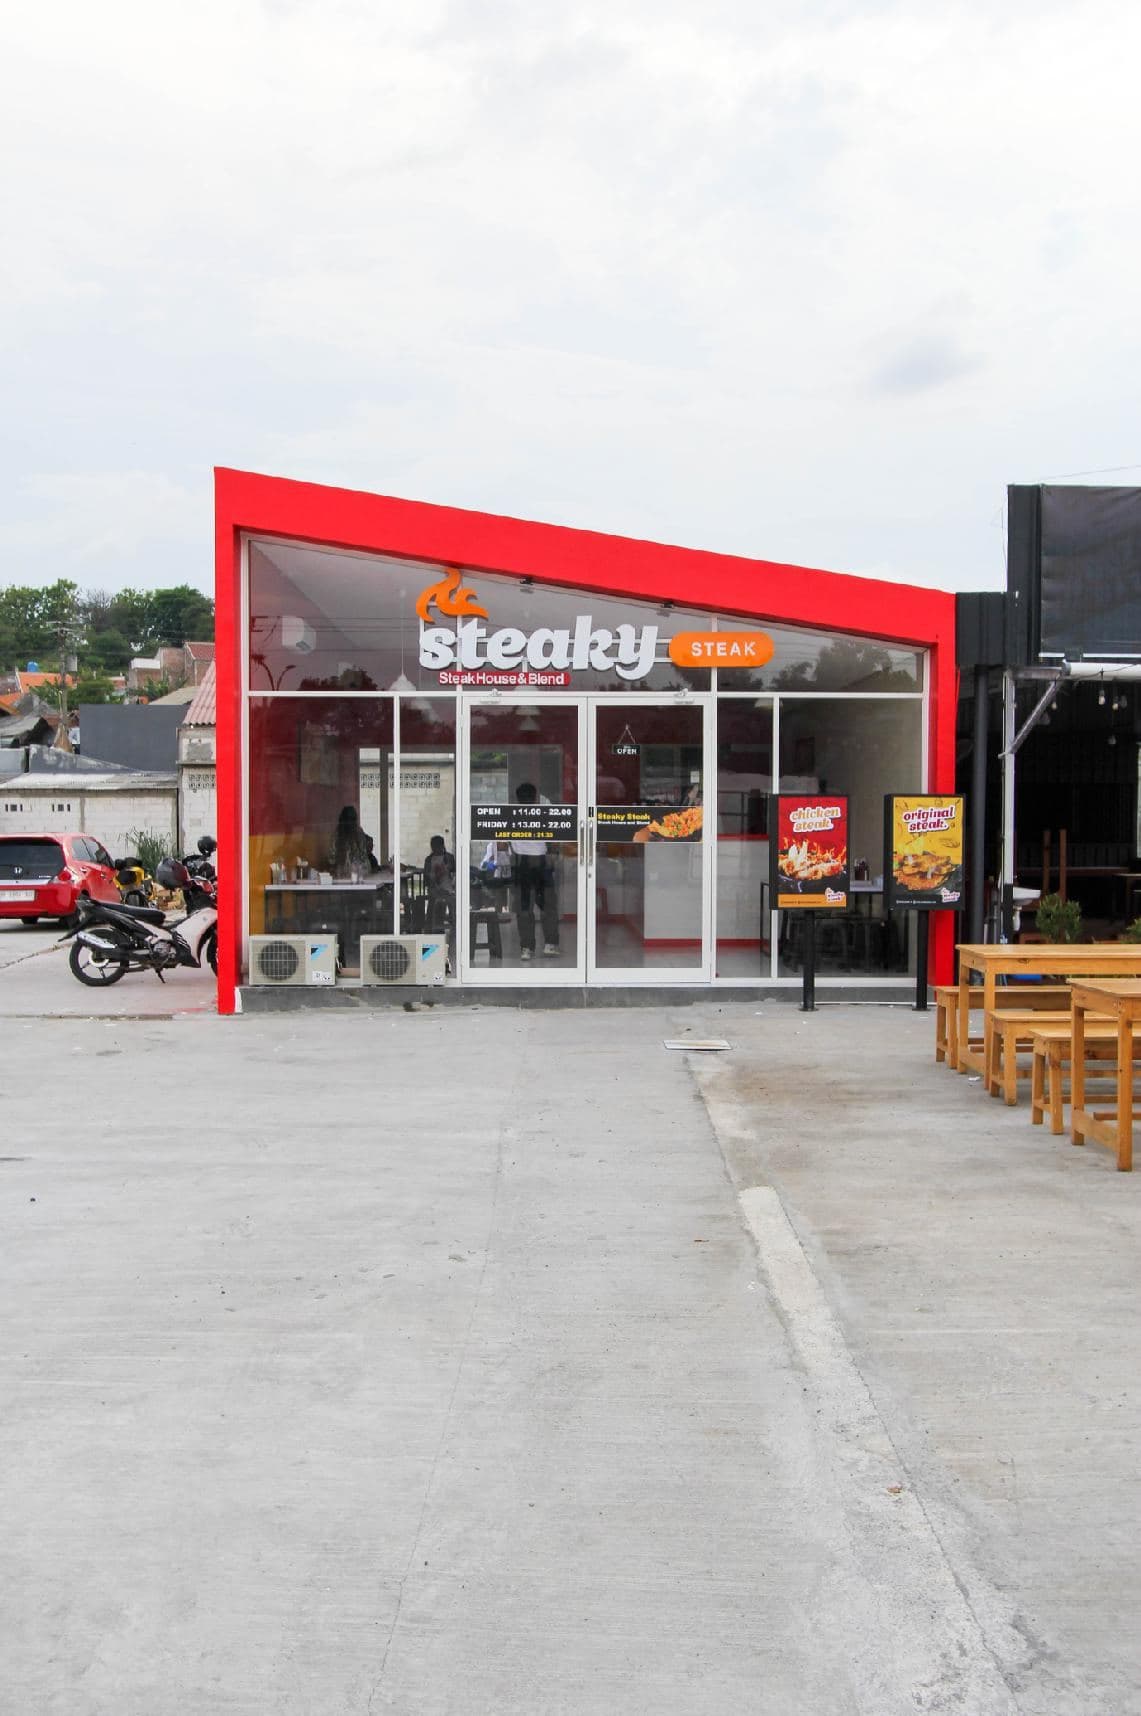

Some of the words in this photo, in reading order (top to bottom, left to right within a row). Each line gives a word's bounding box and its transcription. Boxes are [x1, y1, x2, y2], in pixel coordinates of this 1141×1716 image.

[419, 615, 659, 680] steaky
[690, 641, 756, 657] STEAK
[477, 807, 501, 815] OPEN
[518, 808, 542, 816] 11.00
[548, 808, 573, 816] 22.00
[598, 813, 625, 821] Steaky
[791, 807, 840, 820] chicken
[903, 806, 954, 822] original
[547, 821, 572, 829] 22.00
